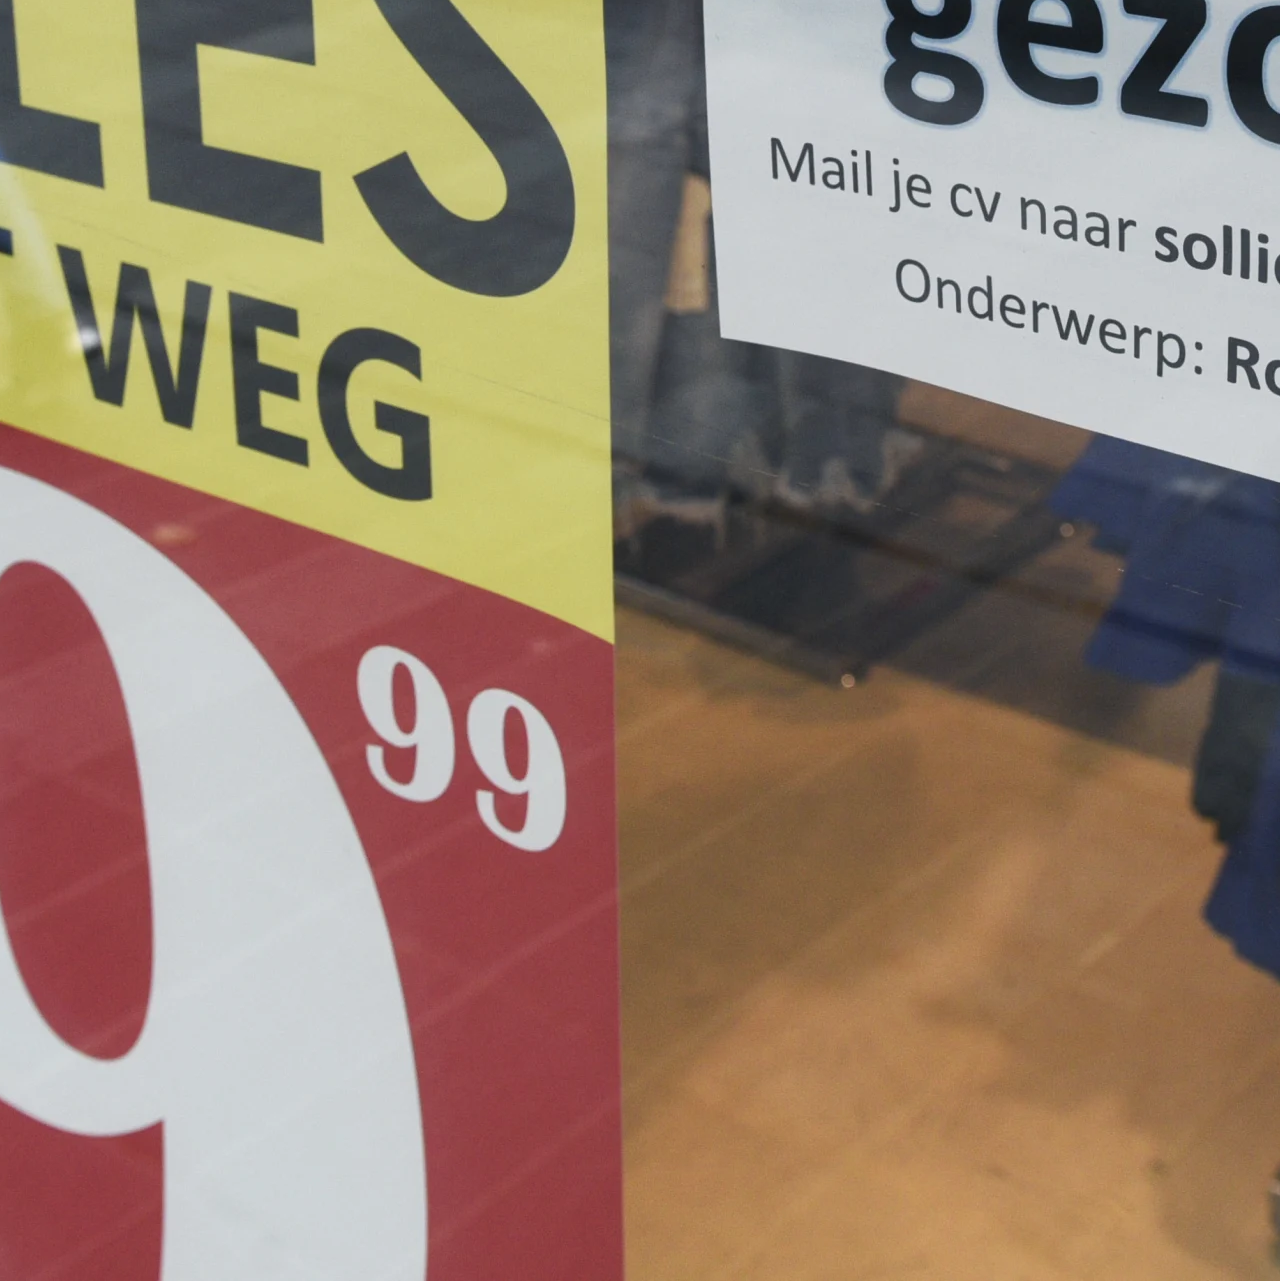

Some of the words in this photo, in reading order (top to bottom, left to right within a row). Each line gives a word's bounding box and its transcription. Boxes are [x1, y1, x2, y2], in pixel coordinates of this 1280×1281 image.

[770, 136, 874, 198] Mail
[887, 161, 932, 214] je
[950, 182, 1001, 224] cv
[1019, 195, 1137, 254] naar
[55, 242, 434, 503] WEG
[894, 257, 1204, 379] Onderwerp:
[355, 644, 568, 853] 99
